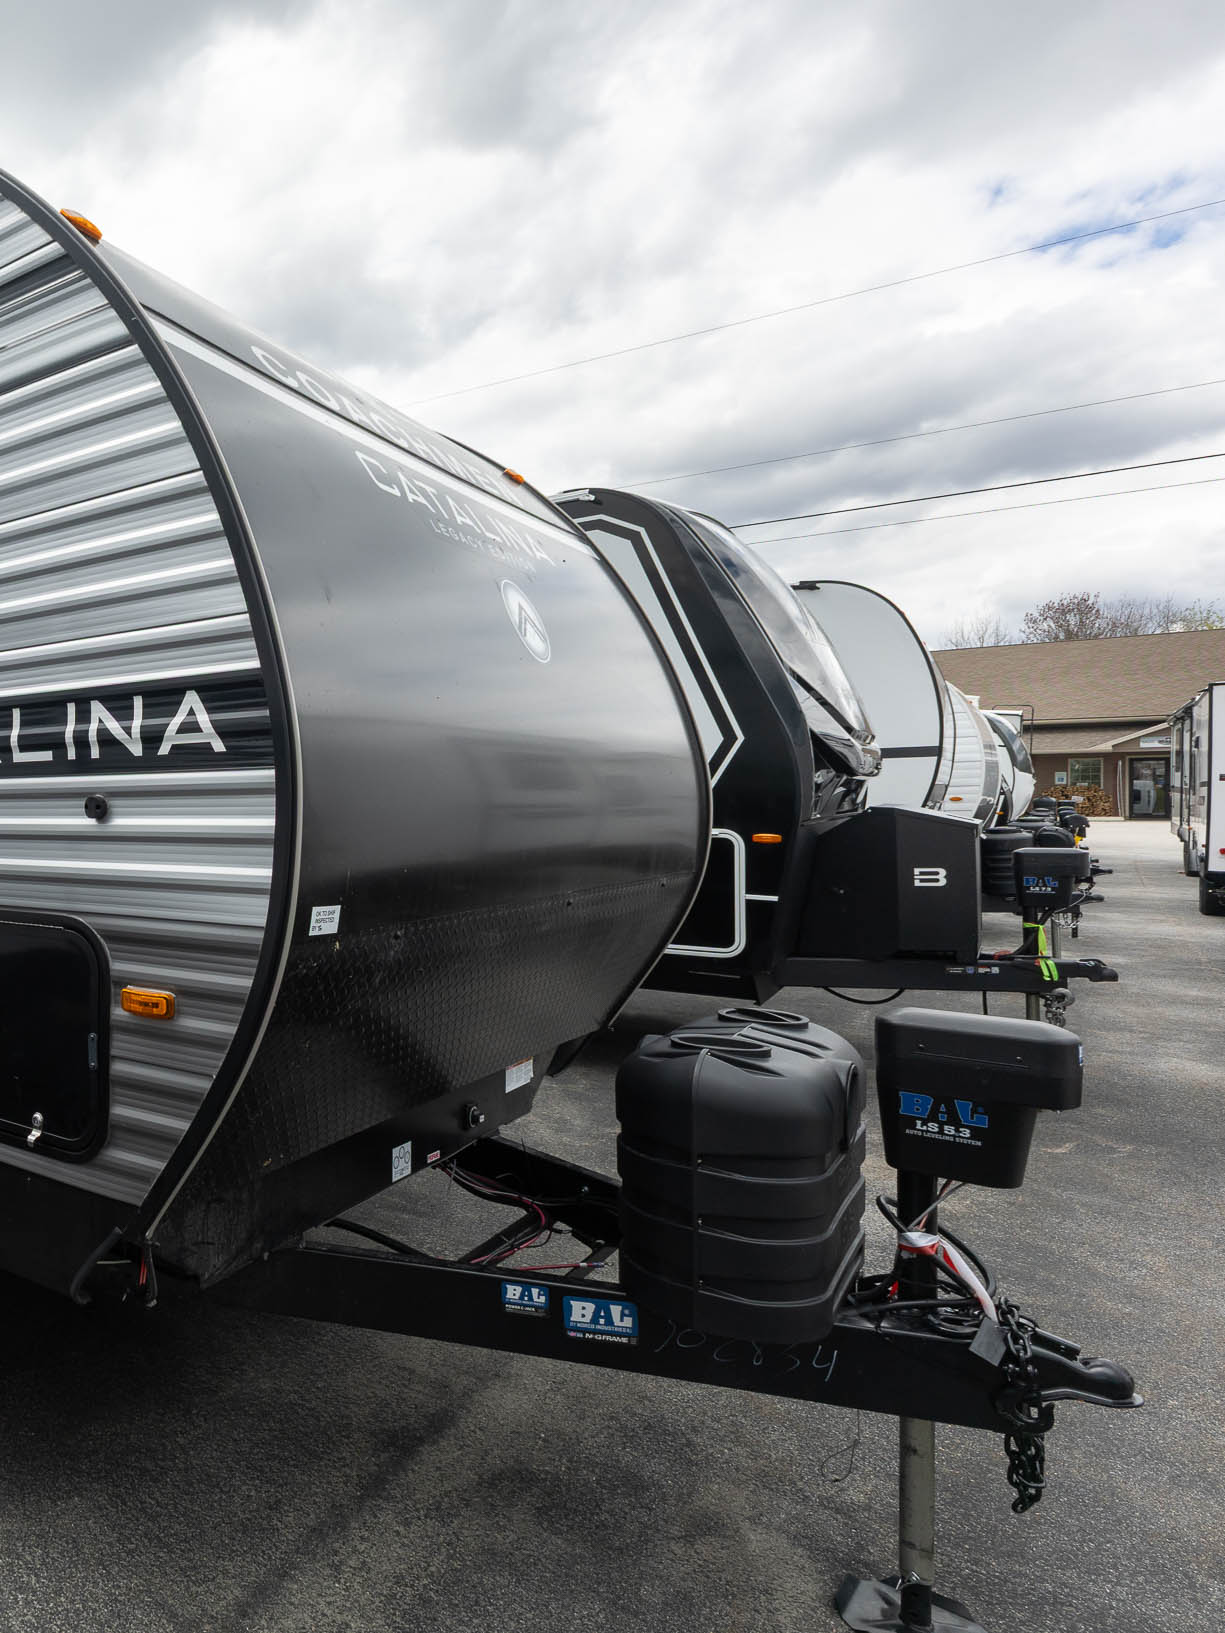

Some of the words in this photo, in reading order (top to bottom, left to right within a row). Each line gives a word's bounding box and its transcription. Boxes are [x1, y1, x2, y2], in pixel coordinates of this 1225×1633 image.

[354, 450, 556, 567] CATALINA
[898, 1091, 989, 1128] BAL
[905, 1128, 922, 1136] AUTO
[923, 1130, 954, 1141] LEVELING
[955, 1136, 982, 1146] SYSTEM
[915, 1119, 939, 1132] LS
[943, 1124, 971, 1138] 5.3
[505, 1284, 546, 1302] BAL
[570, 1300, 633, 1327] BAL
